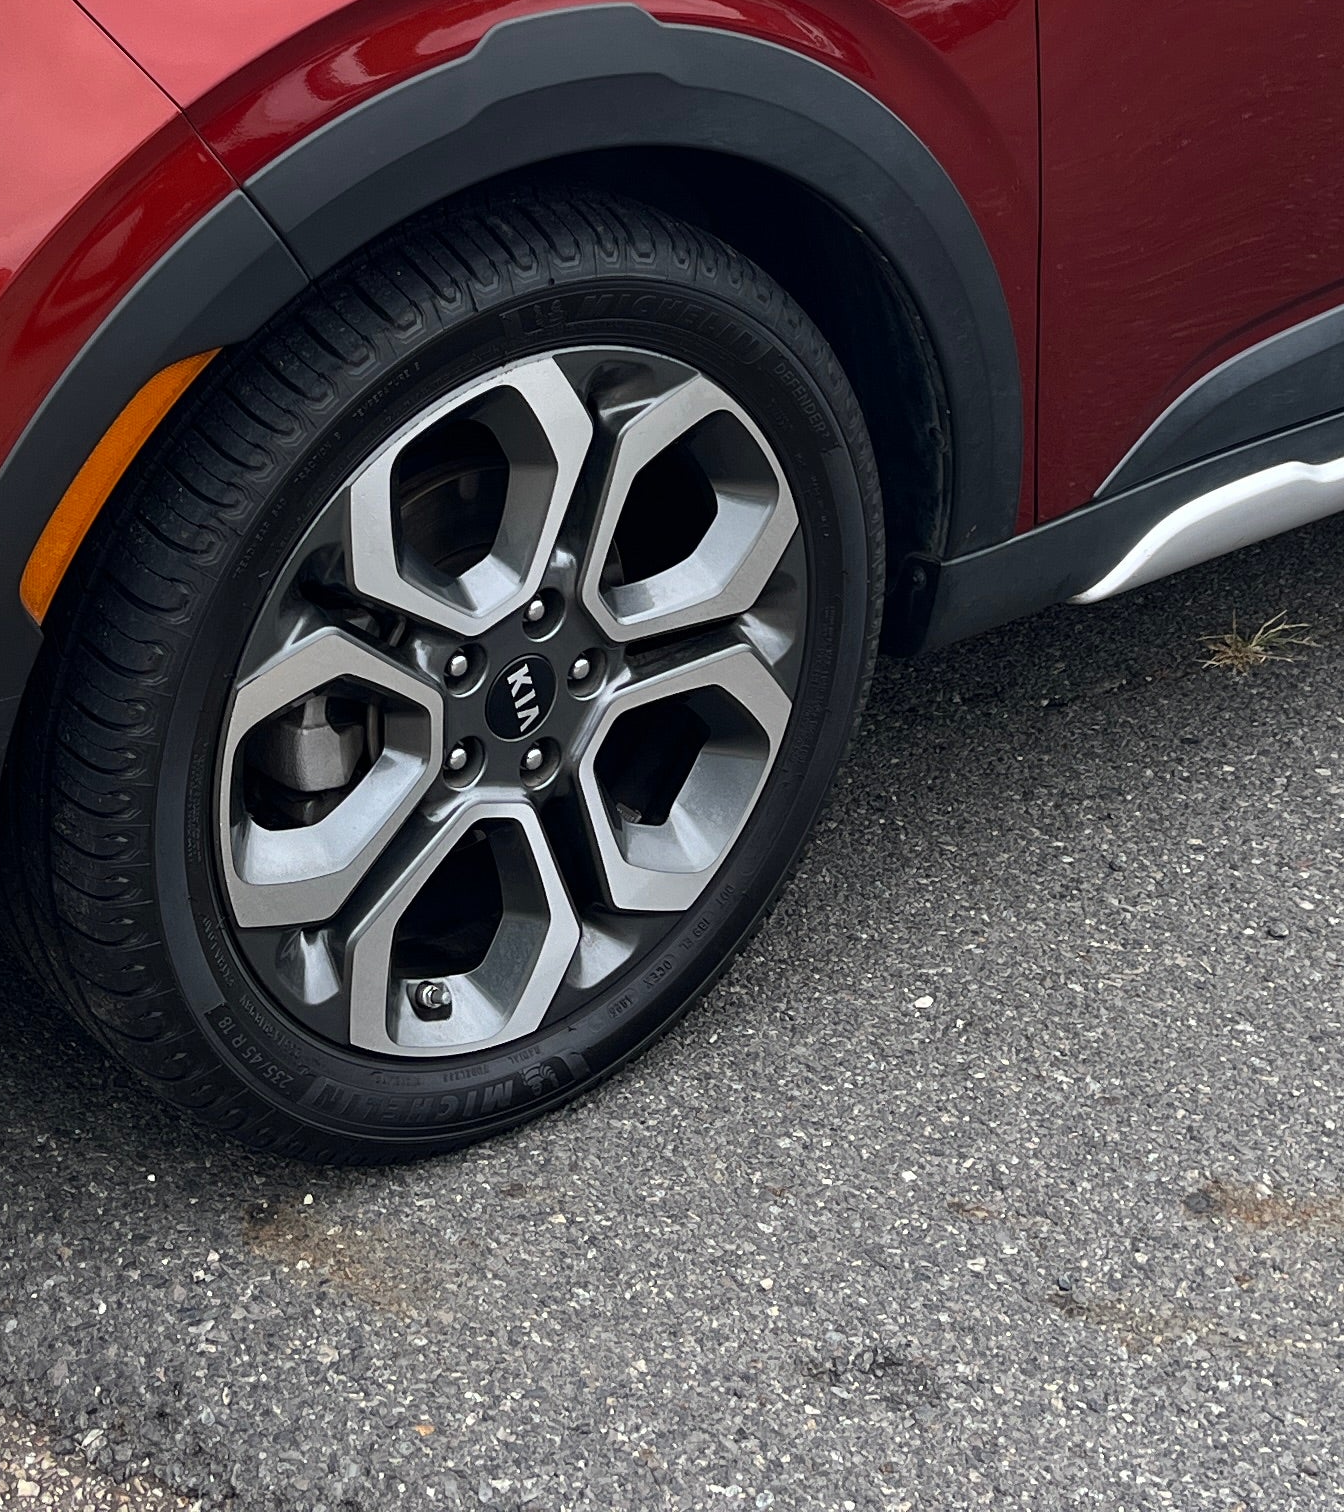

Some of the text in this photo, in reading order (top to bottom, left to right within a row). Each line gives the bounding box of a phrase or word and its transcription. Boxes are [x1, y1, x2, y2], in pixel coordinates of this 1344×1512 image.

[506, 663, 541, 733] KIA
[217, 1015, 295, 1089] 235/45 R 18
[312, 1078, 514, 1122] MICHELIN
